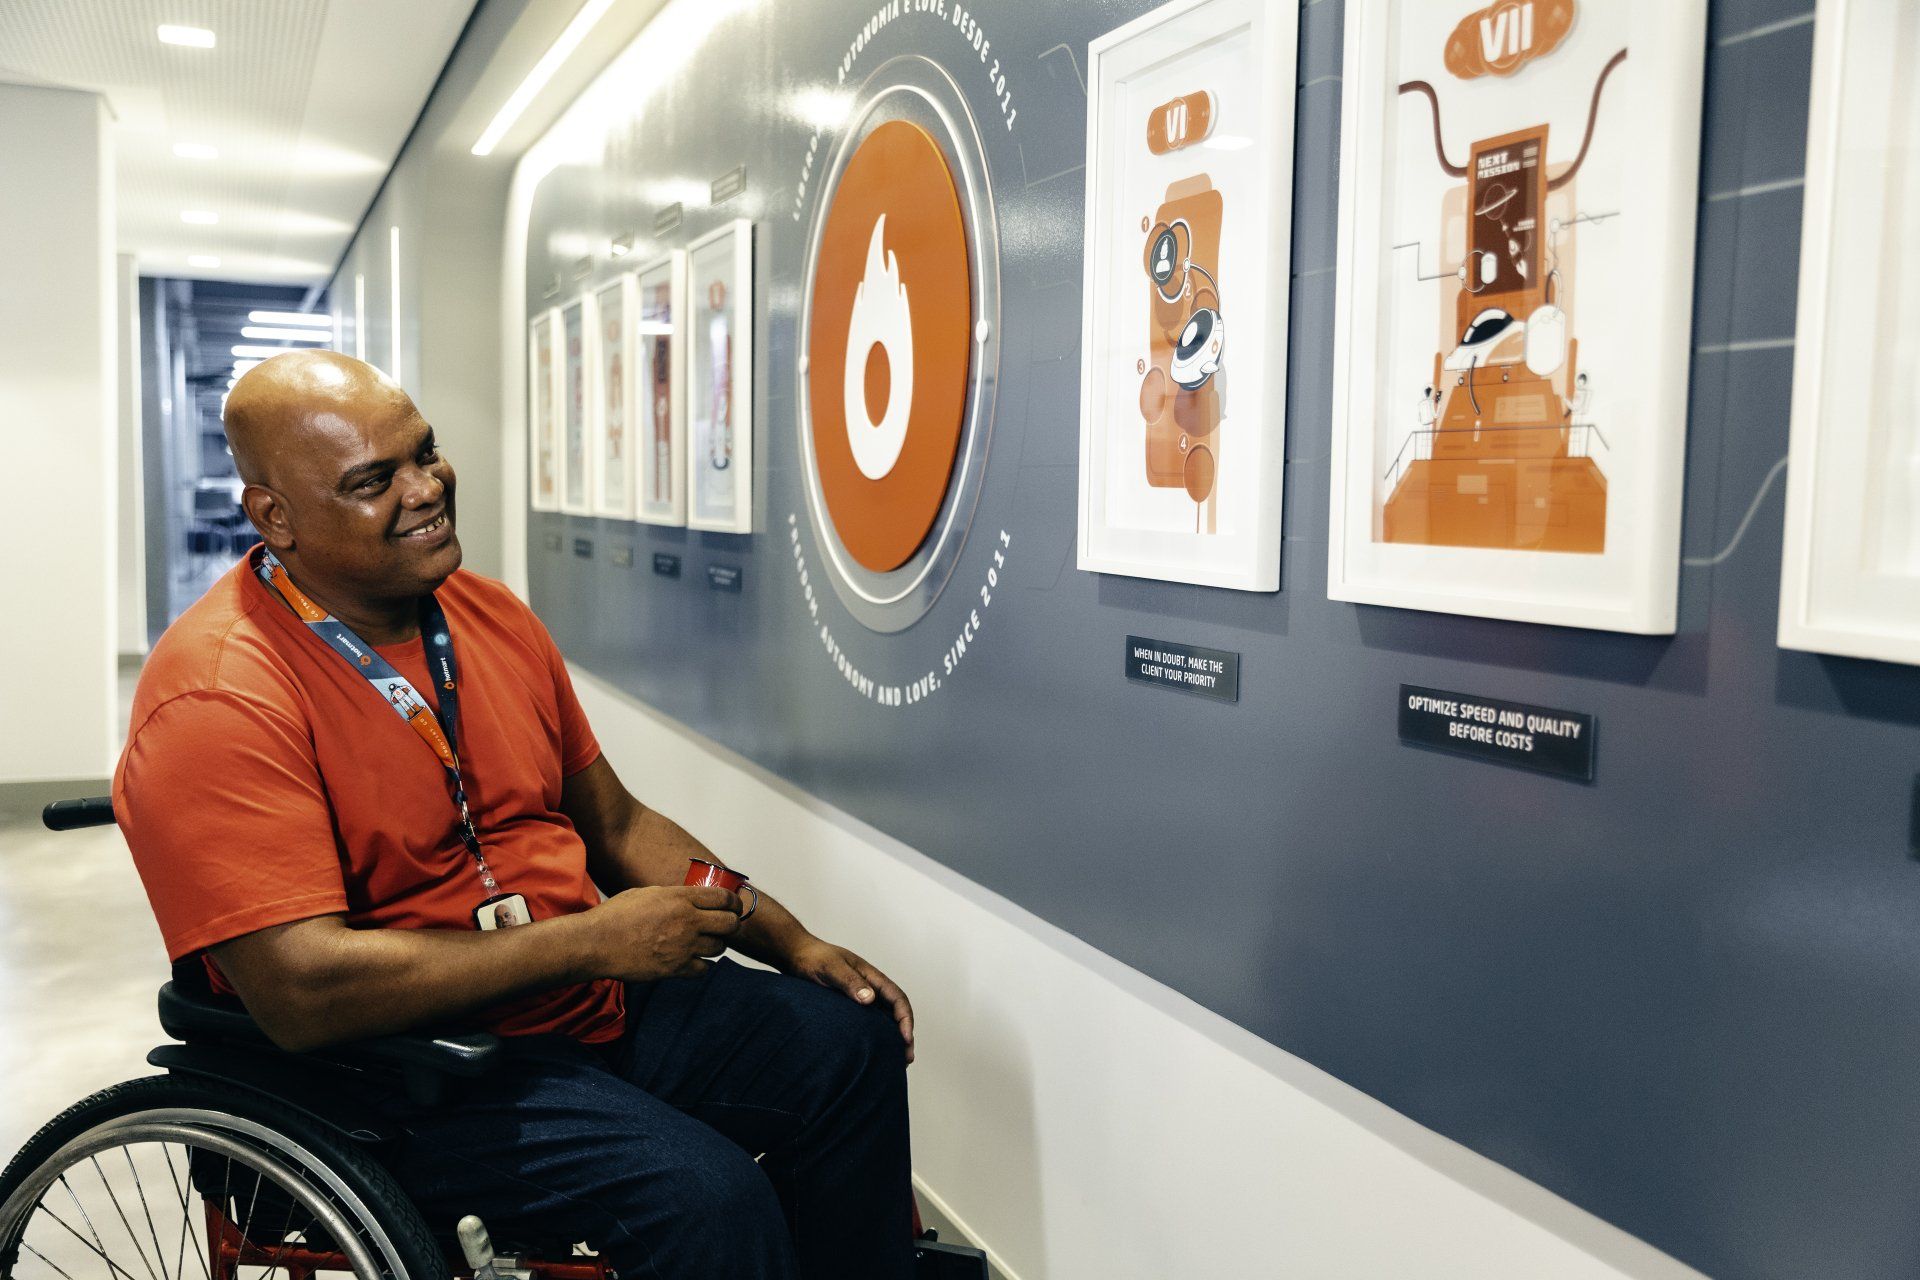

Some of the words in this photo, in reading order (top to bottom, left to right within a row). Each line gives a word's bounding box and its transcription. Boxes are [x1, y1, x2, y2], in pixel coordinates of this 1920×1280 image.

[1480, 3, 1533, 63] VII
[952, 4, 990, 63] DESDE
[989, 59, 1017, 132] 2011
[1166, 104, 1187, 143] VI
[1477, 161, 1520, 180] MISSION
[1478, 151, 1508, 170] NEXT
[820, 625, 875, 699] AUTONOMY
[877, 685, 901, 707] AND
[905, 671, 941, 705] LOVE,
[943, 608, 980, 675] SINCE
[980, 529, 1011, 607] 2011
[336, 633, 363, 658] hotmart
[1134, 646, 1153, 661] WHEN
[1154, 650, 1161, 663] IN
[1162, 652, 1187, 668] DOUBT,
[1188, 657, 1208, 671] MAKE
[1209, 660, 1224, 674] THE
[440, 657, 452, 681] hotmart
[1141, 663, 1163, 678] CLIENT
[1164, 668, 1182, 682] YOUR
[1183, 671, 1216, 688] PRIORITY
[1408, 695, 1458, 717] OPTIMIZE
[1459, 703, 1496, 724] SPEED
[1498, 710, 1524, 729] AND
[1526, 715, 1582, 739] QUALITY
[1448, 722, 1493, 744] BEFORE
[1495, 730, 1534, 752] COSTS
